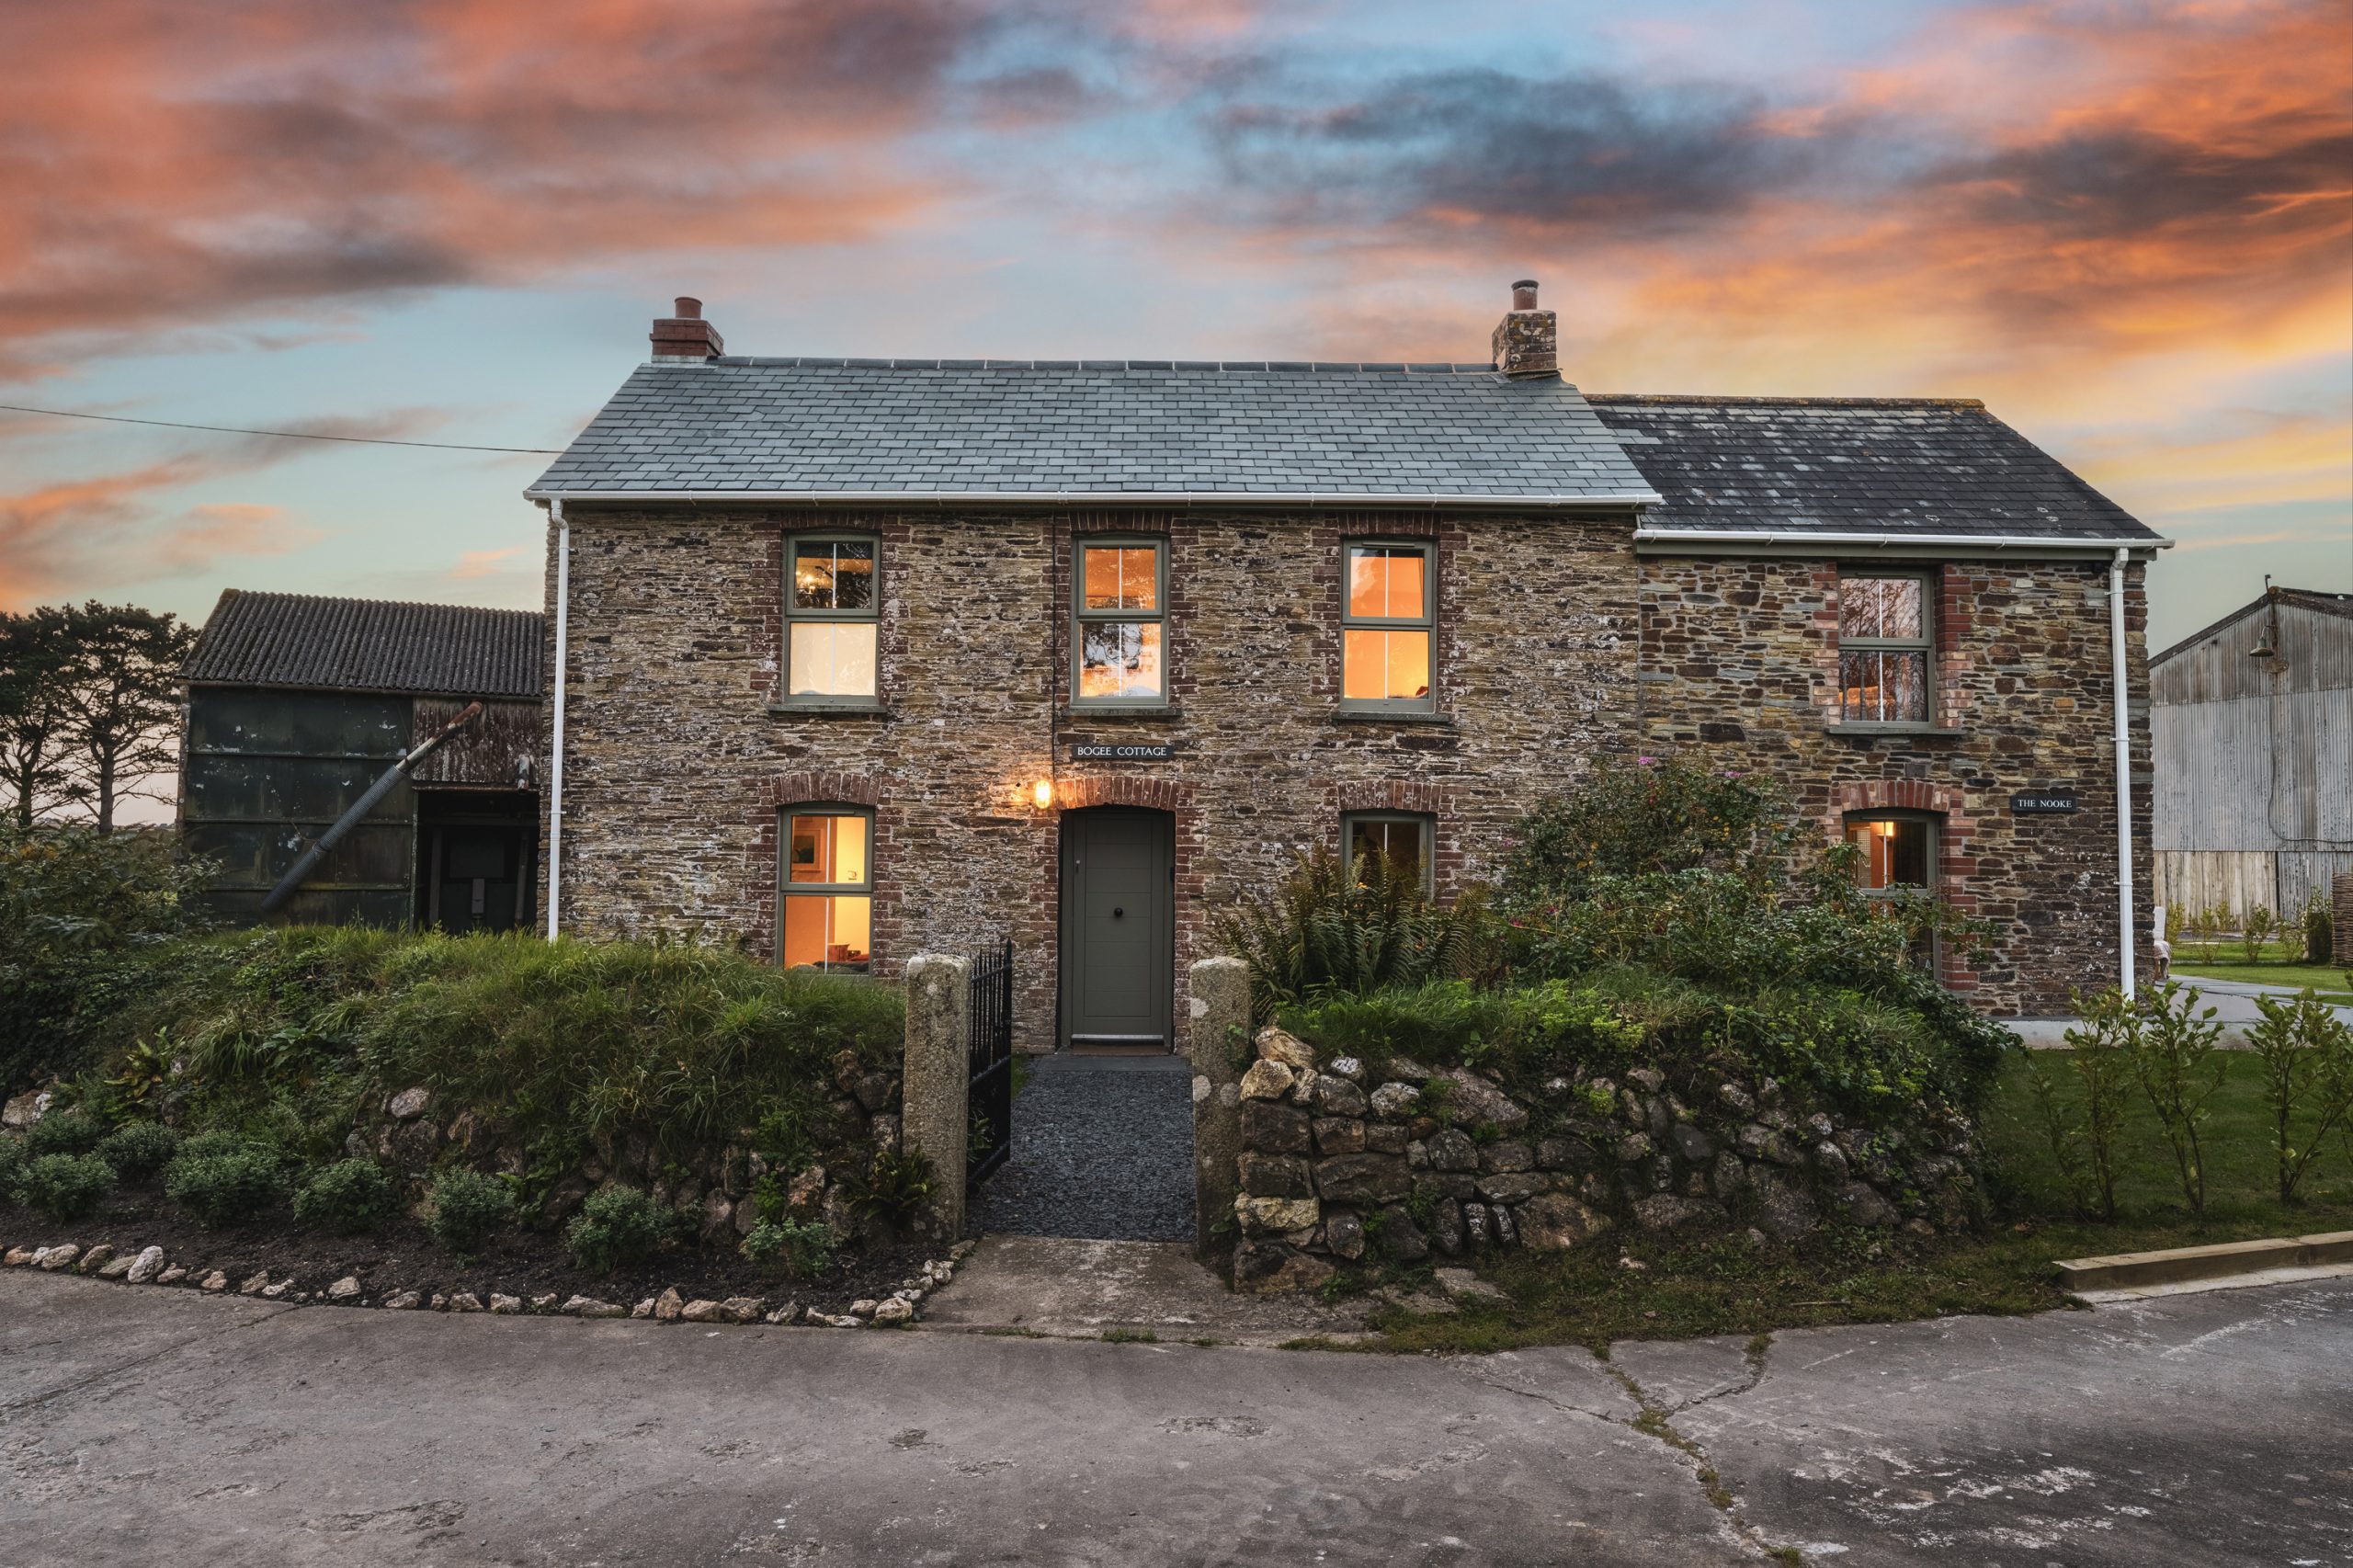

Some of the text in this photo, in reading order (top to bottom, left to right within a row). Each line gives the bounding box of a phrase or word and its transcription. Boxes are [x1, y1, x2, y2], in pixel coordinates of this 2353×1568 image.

[1077, 746, 1166, 756] BOGEE COTTAGE
[2018, 799, 2072, 808] THE NOOKE
